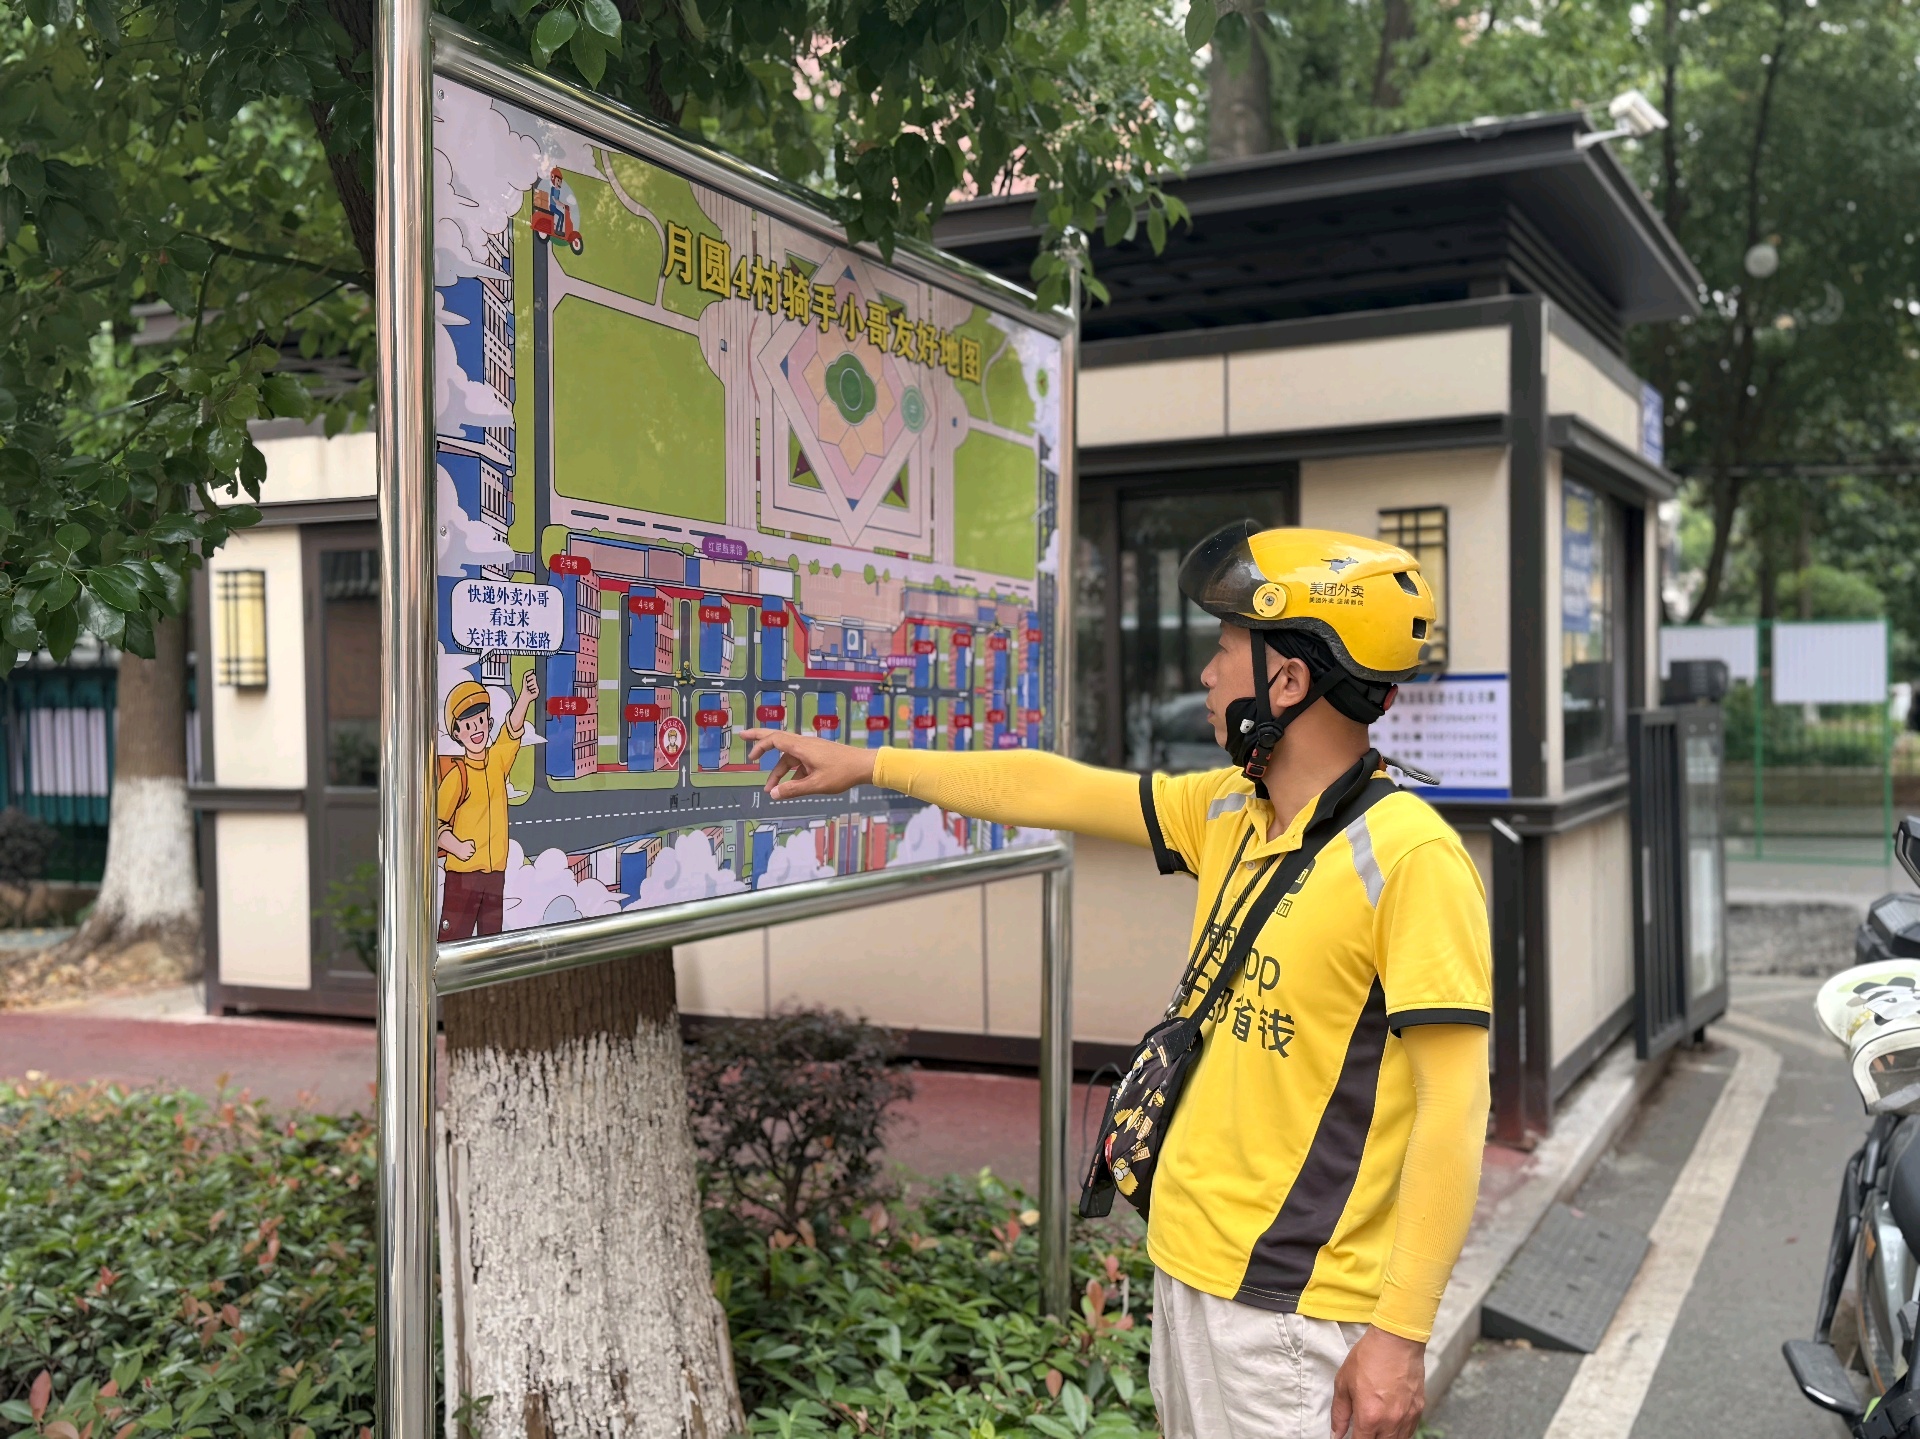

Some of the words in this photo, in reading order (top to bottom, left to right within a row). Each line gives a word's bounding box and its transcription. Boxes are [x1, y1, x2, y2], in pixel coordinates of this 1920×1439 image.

[664, 221, 982, 384] 月圆4村骑手小哥友好地图
[560, 557, 578, 570] 2号楼
[467, 584, 550, 608] 快递外卖小哥
[1309, 581, 1364, 599] 美团外卖
[638, 599, 655, 611] 4号楼
[489, 608, 530, 628] 看过来
[705, 608, 720, 620] 6号楼
[466, 628, 508, 647] 关注我
[511, 629, 551, 650] 不迷路
[558, 700, 577, 711] 1号楼
[634, 707, 650, 718] 3号楼
[703, 712, 718, 723] 5号楼
